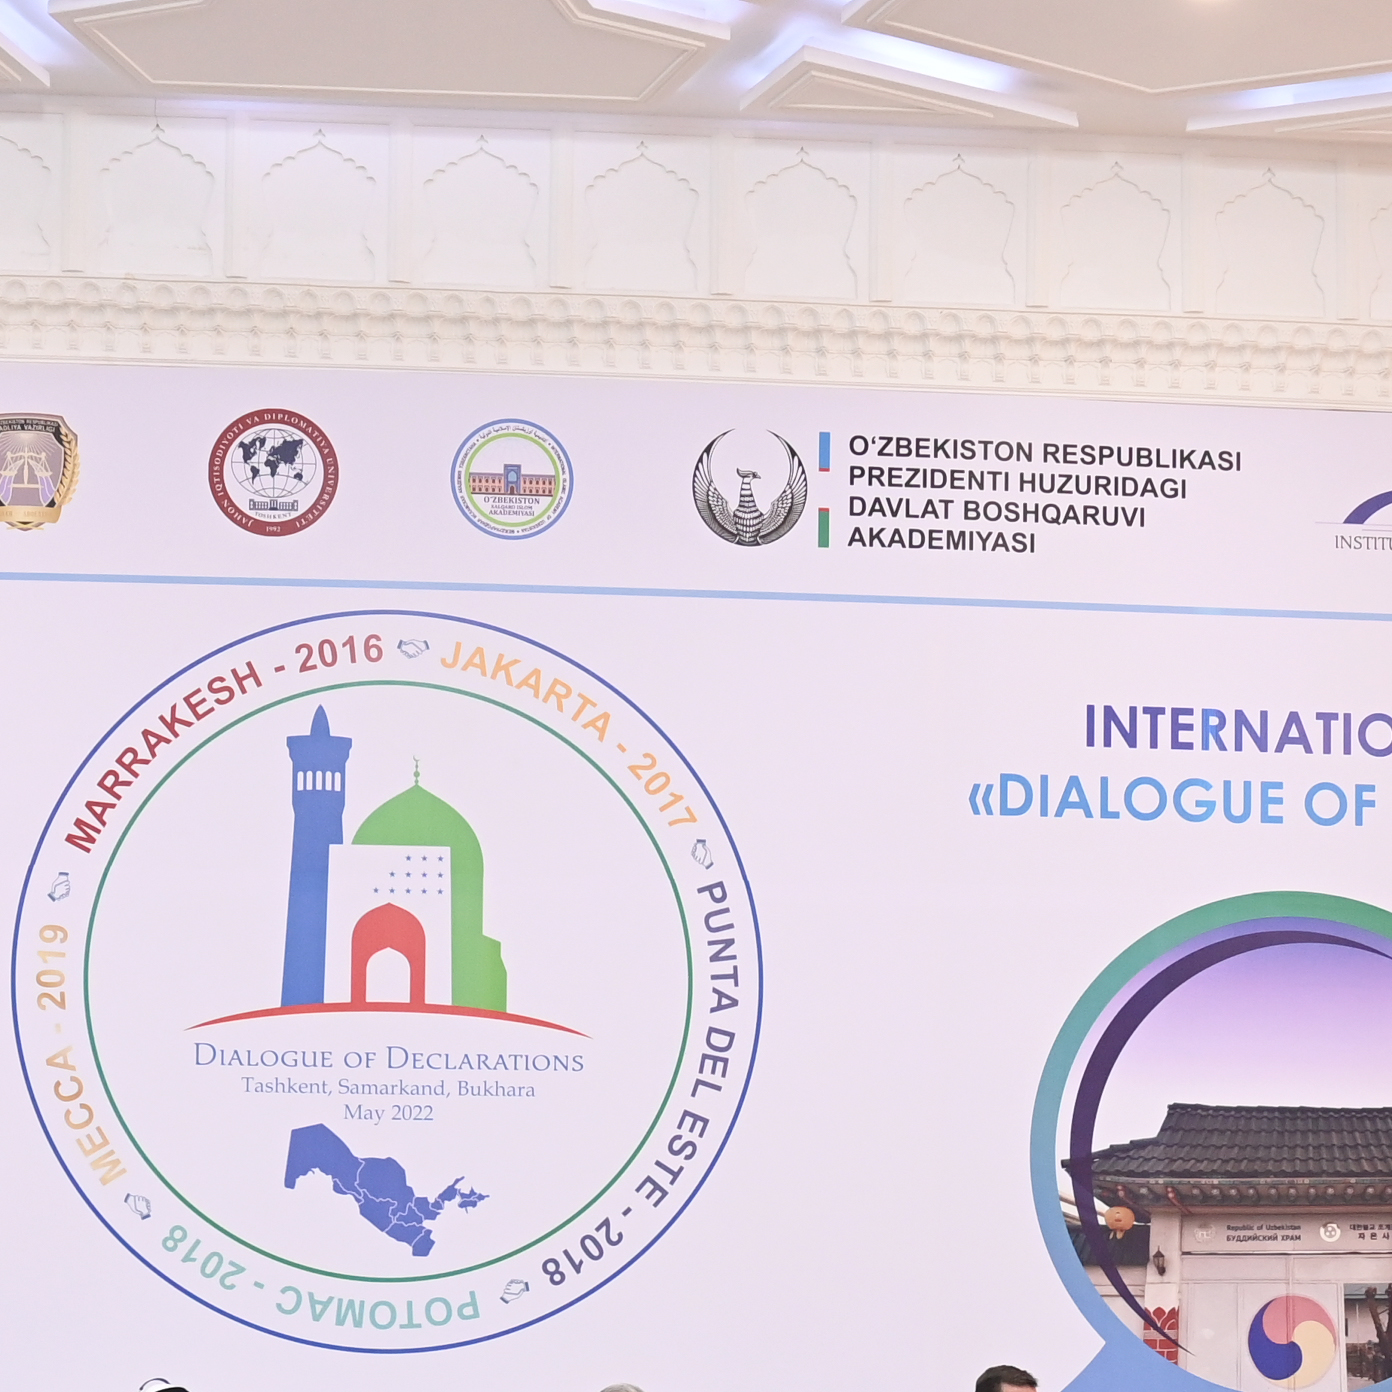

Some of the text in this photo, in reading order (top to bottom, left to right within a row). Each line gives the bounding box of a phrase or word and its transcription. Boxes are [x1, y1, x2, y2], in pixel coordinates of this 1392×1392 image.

[213, 413, 335, 527] JAHON IQTISODIYOTI VA DIPLOMATIYA UNIVERSITETI
[849, 466, 1187, 499] PREZIDENTI HUZURIDAGI
[1043, 442, 1242, 471] RESPUBLIKASI
[847, 527, 1036, 553] AKADEMIYASI
[849, 495, 1146, 527] DAVLAT BOSHQARUVI
[64, 660, 263, 854] MARRAKESH
[294, 634, 384, 673] 2016
[440, 641, 611, 743] JAKARTA
[627, 752, 698, 827] 2017
[968, 772, 1286, 826] «DIALOGUE
[1304, 782, 1378, 827] OF
[36, 923, 70, 1011] 2019
[696, 880, 739, 1015] PUNTA
[241, 1076, 536, 1099] Tashkent, Samarkand, Bukhara
[690, 1026, 736, 1098] DEL
[45, 1045, 127, 1187] MECCA
[343, 1104, 434, 1126] May 2022
[634, 1109, 710, 1208] ESTE
[161, 1223, 247, 1291] 2018
[541, 1217, 624, 1287] 2018
[275, 1285, 481, 1331] POTOMAC
